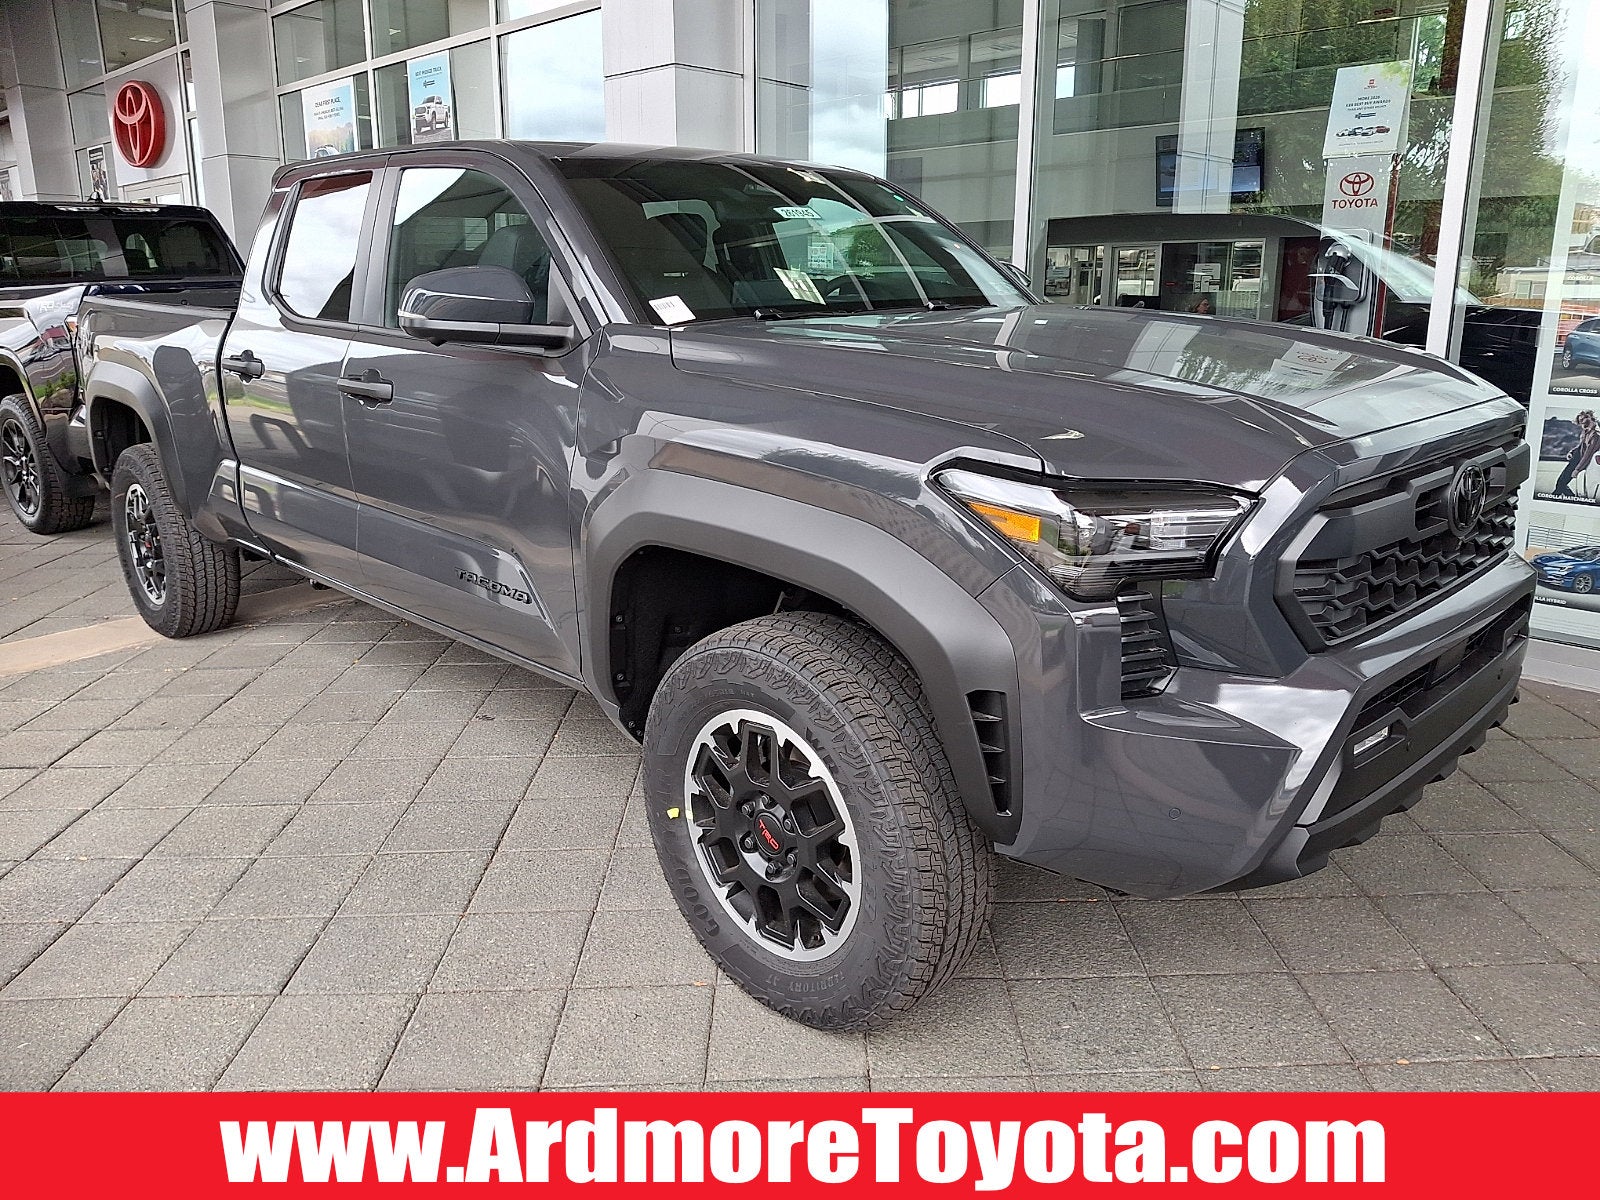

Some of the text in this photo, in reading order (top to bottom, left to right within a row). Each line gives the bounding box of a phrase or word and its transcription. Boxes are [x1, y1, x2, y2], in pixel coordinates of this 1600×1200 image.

[1332, 198, 1378, 209] TOYOTA
[454, 566, 532, 604] TACOMA
[759, 819, 780, 850] TRD
